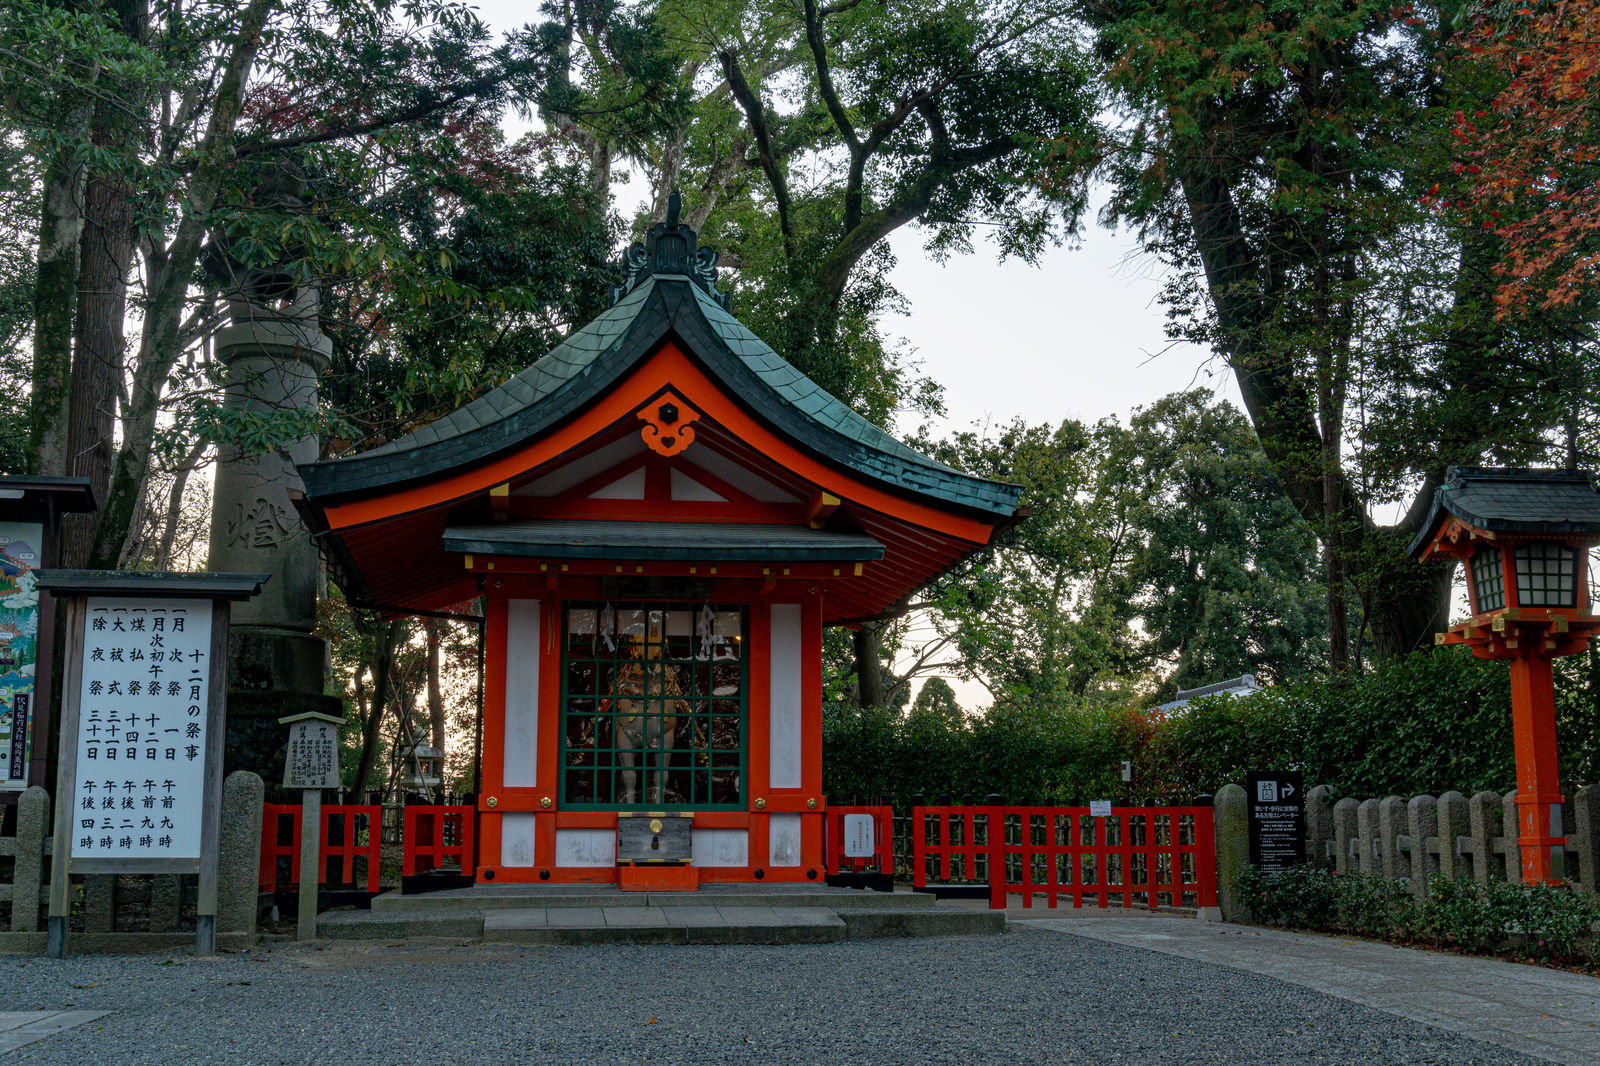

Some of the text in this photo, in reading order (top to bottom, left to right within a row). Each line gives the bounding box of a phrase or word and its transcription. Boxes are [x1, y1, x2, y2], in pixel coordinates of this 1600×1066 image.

[85, 710, 102, 760] 三十一日
[105, 710, 121, 760] 三十一日
[125, 712, 141, 760] 十四日
[144, 713, 160, 761] 十二日
[184, 649, 205, 762] 十二月の祭事
[163, 727, 180, 761] 一日
[80, 779, 97, 849] 午後四時
[100, 779, 117, 849] 午後三時
[119, 779, 137, 849] 午後二時
[139, 778, 157, 848] 午前九時
[159, 778, 176, 848] 午前九時
